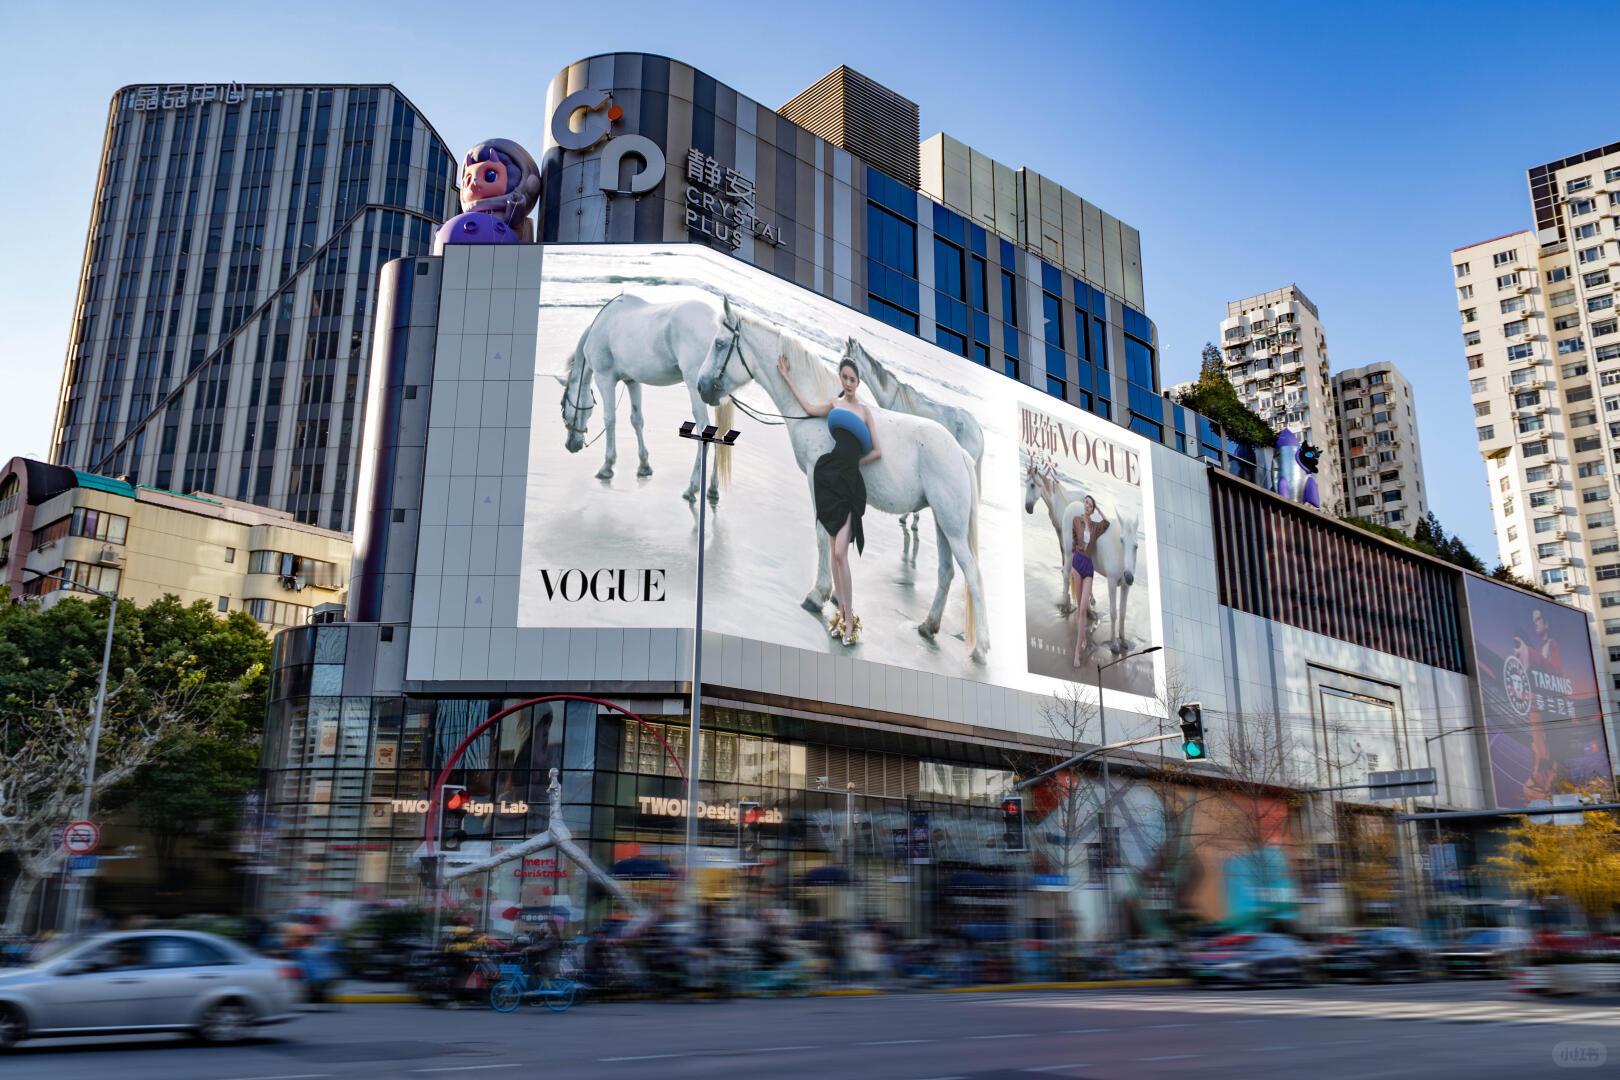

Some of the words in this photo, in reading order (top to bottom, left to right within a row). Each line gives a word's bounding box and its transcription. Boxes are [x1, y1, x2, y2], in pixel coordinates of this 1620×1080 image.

[134, 80, 245, 111] 晶品中心
[687, 148, 756, 208] 静安
[685, 210, 743, 249] PLUS
[686, 186, 786, 246] CRYSTAL
[1021, 407, 1057, 455] 服饰
[1056, 422, 1141, 487] VOGUE
[538, 568, 666, 602] VOGUE
[1531, 670, 1573, 696] TARANIS
[392, 800, 433, 813] TWO
[462, 800, 493, 816] sign
[501, 801, 528, 813] Lab
[697, 801, 748, 824] Desig
